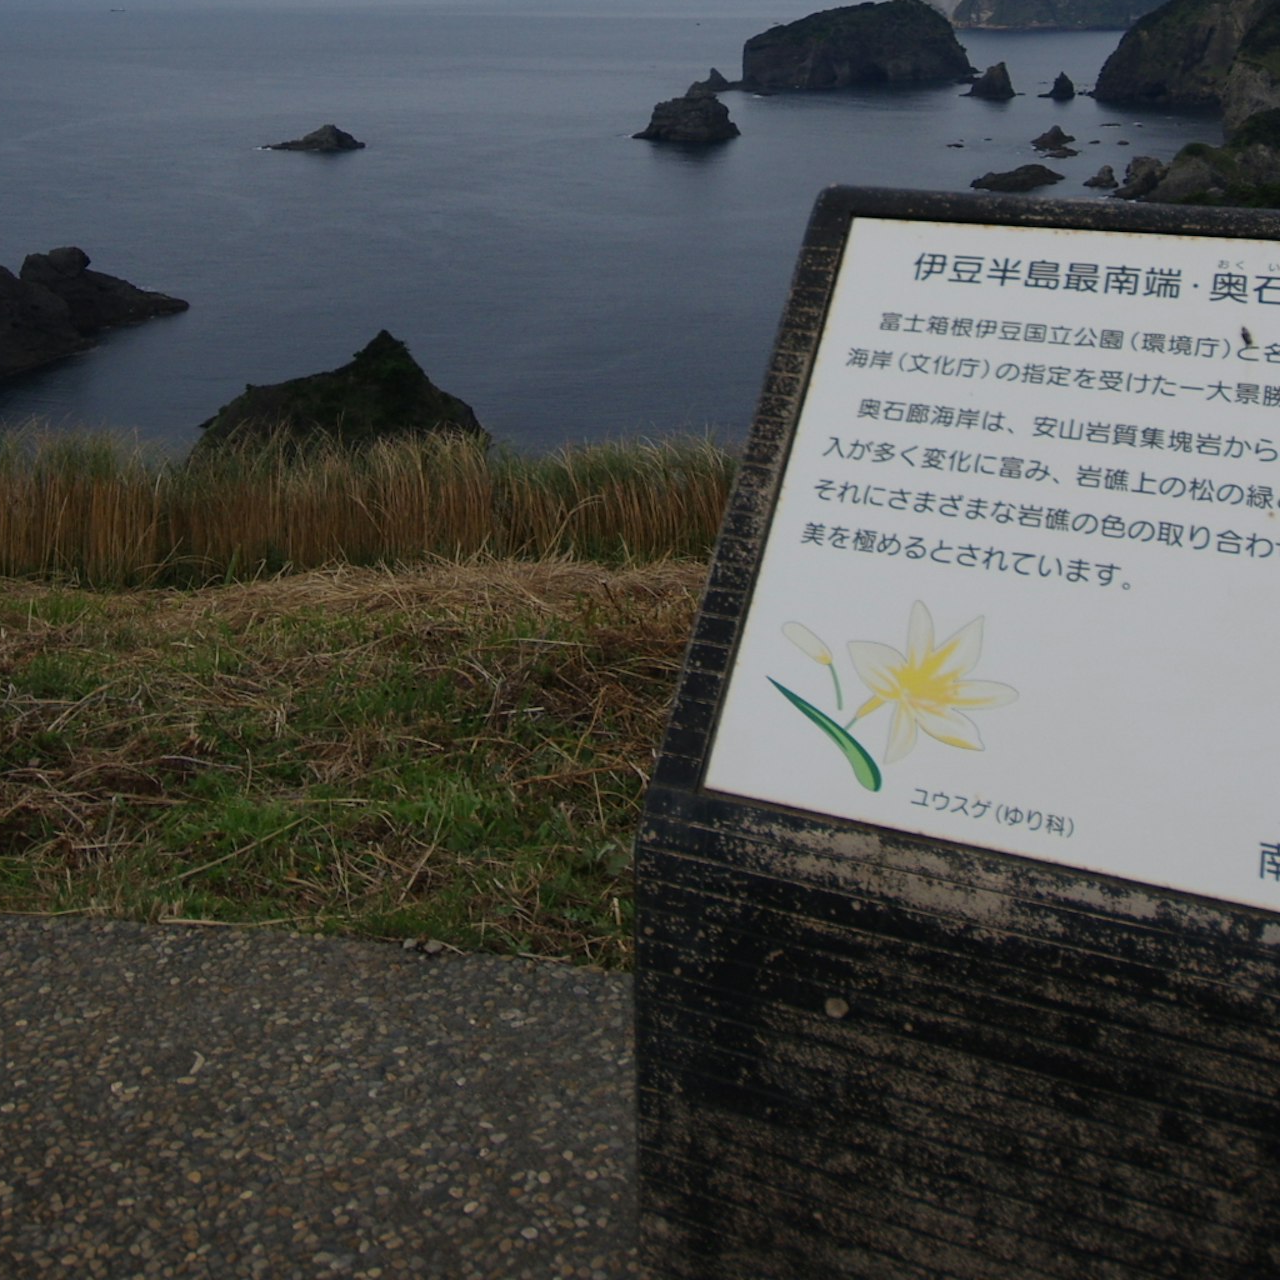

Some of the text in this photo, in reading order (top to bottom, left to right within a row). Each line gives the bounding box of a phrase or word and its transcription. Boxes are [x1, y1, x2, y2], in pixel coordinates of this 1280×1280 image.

[800, 521, 1131, 591] 美を極めるとされています。
